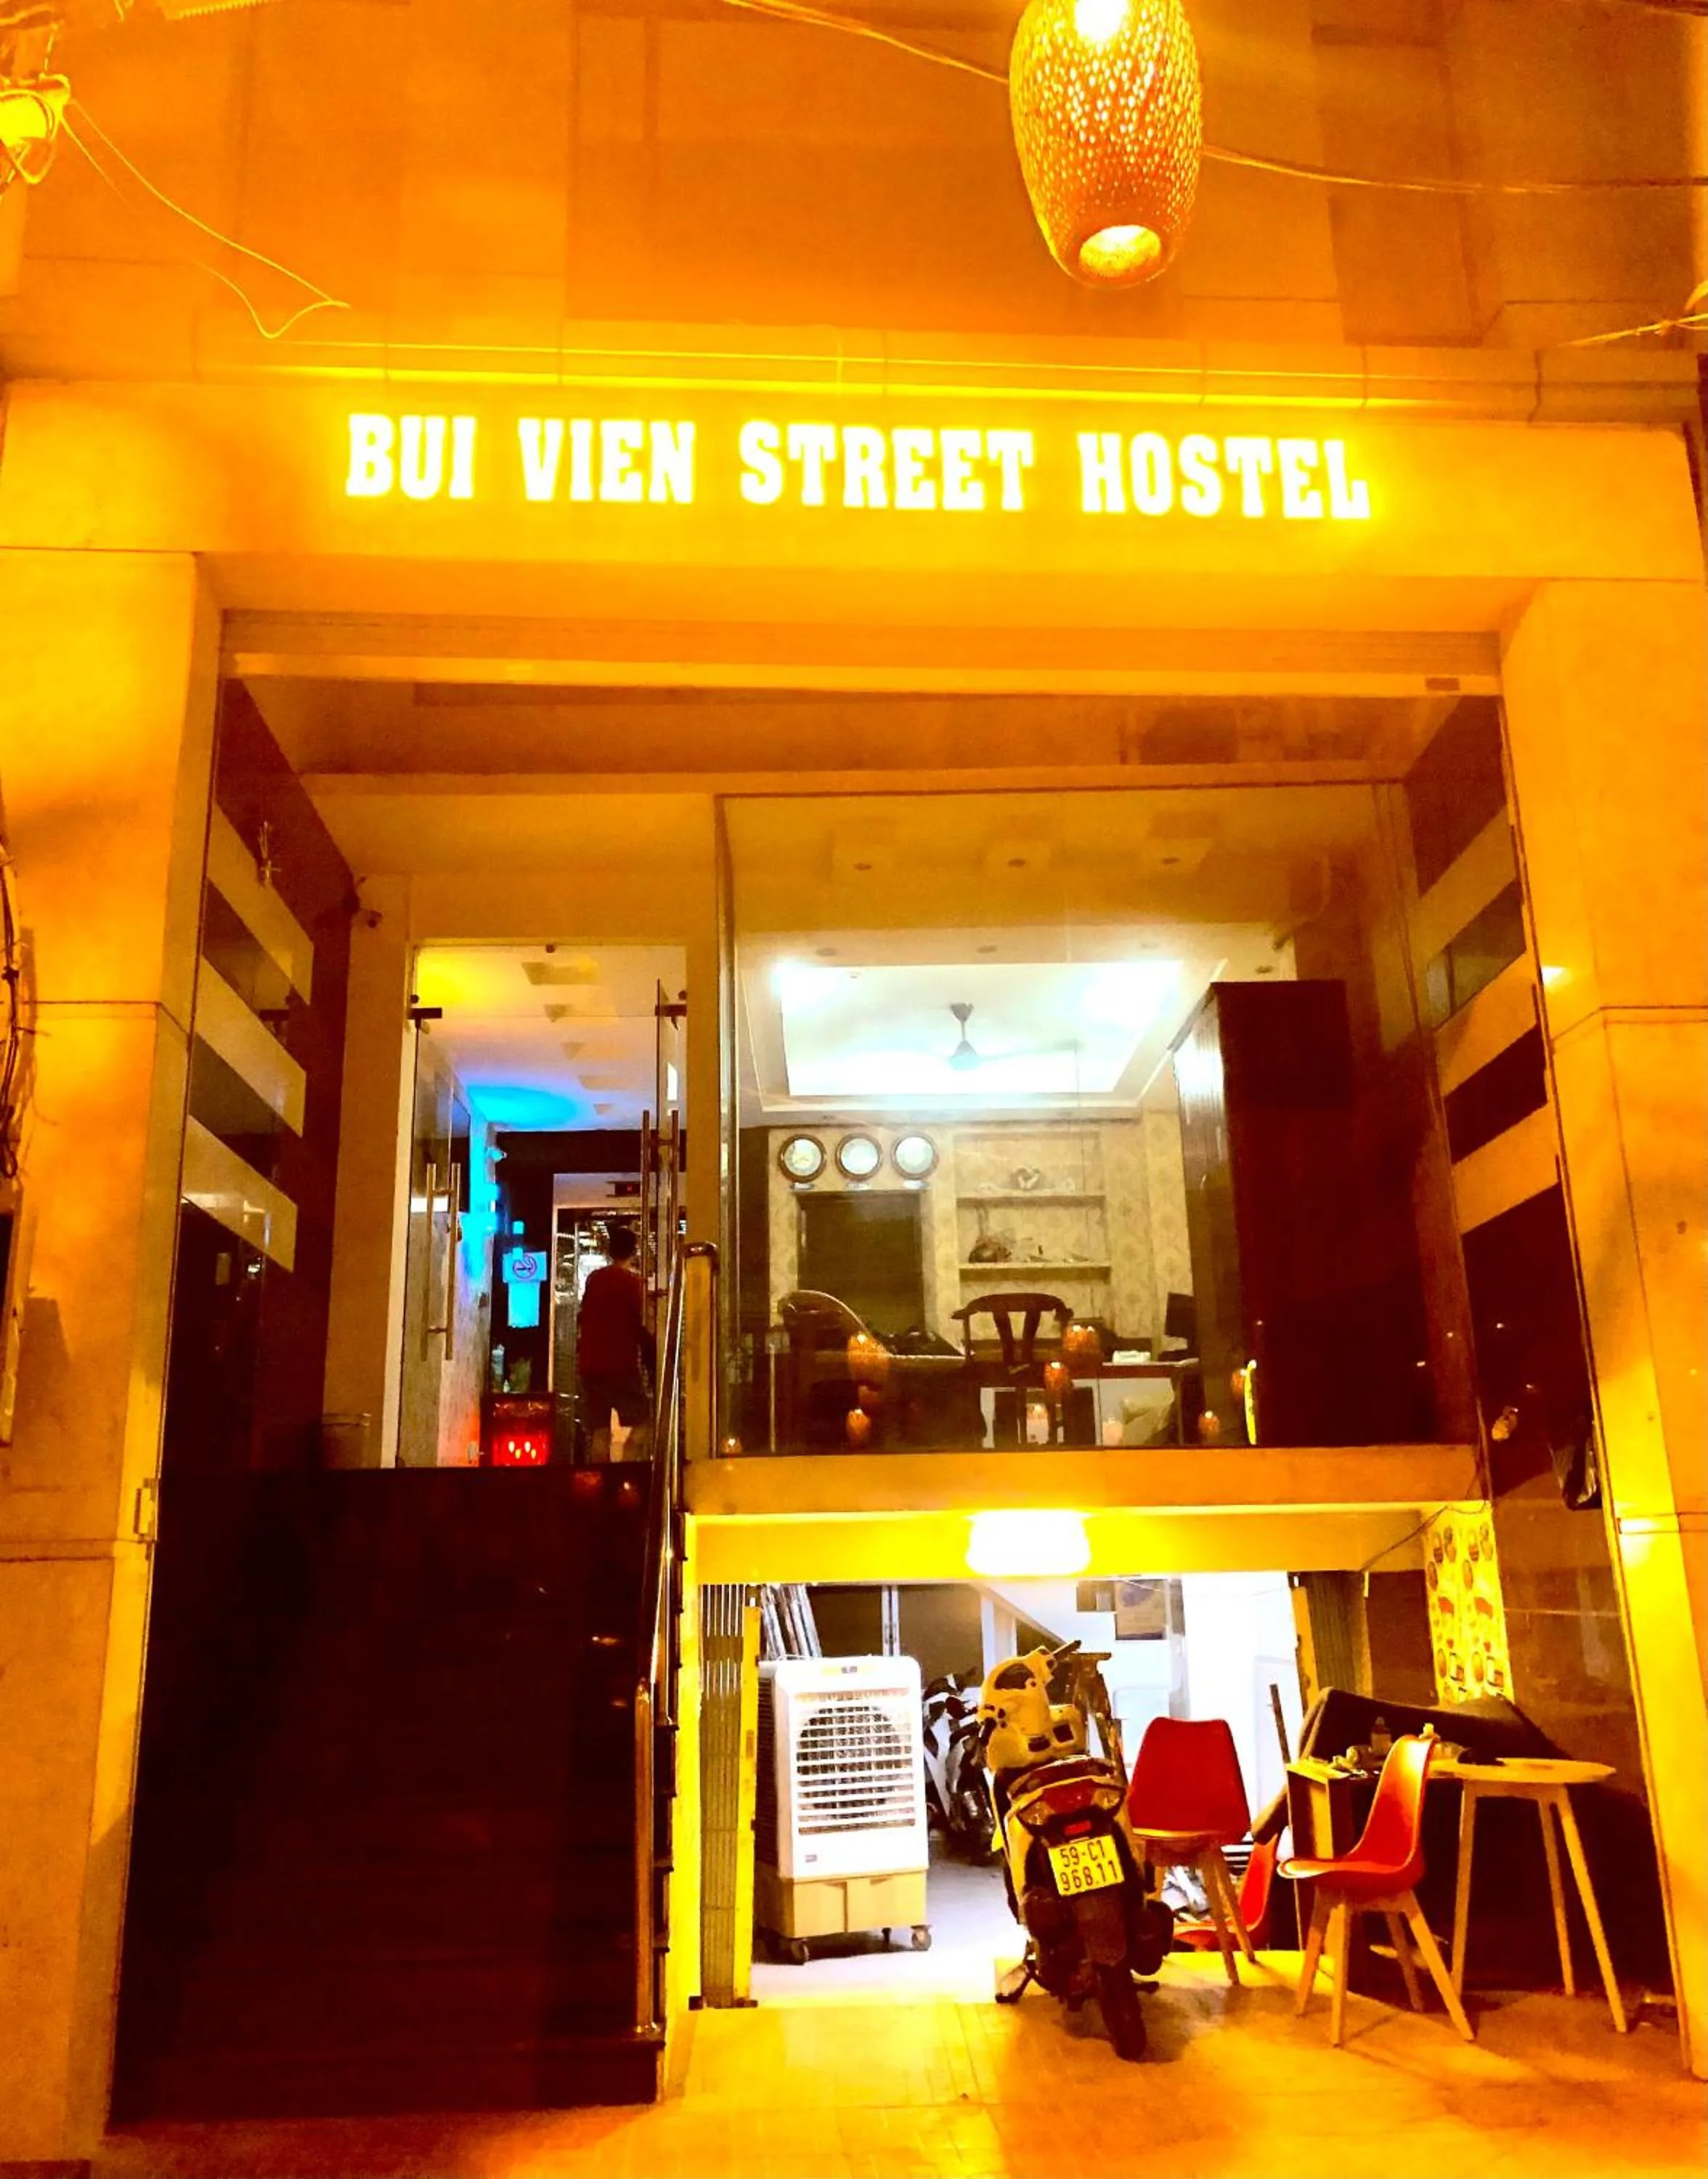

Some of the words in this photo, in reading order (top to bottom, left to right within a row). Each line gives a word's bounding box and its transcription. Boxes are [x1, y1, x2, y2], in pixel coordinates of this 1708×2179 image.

[346, 414, 475, 499] BUI
[519, 418, 694, 503] VIEN
[740, 421, 1033, 510] STREET
[1078, 433, 1370, 519] HOSTEL
[1060, 1859, 1118, 1891] 968.11
